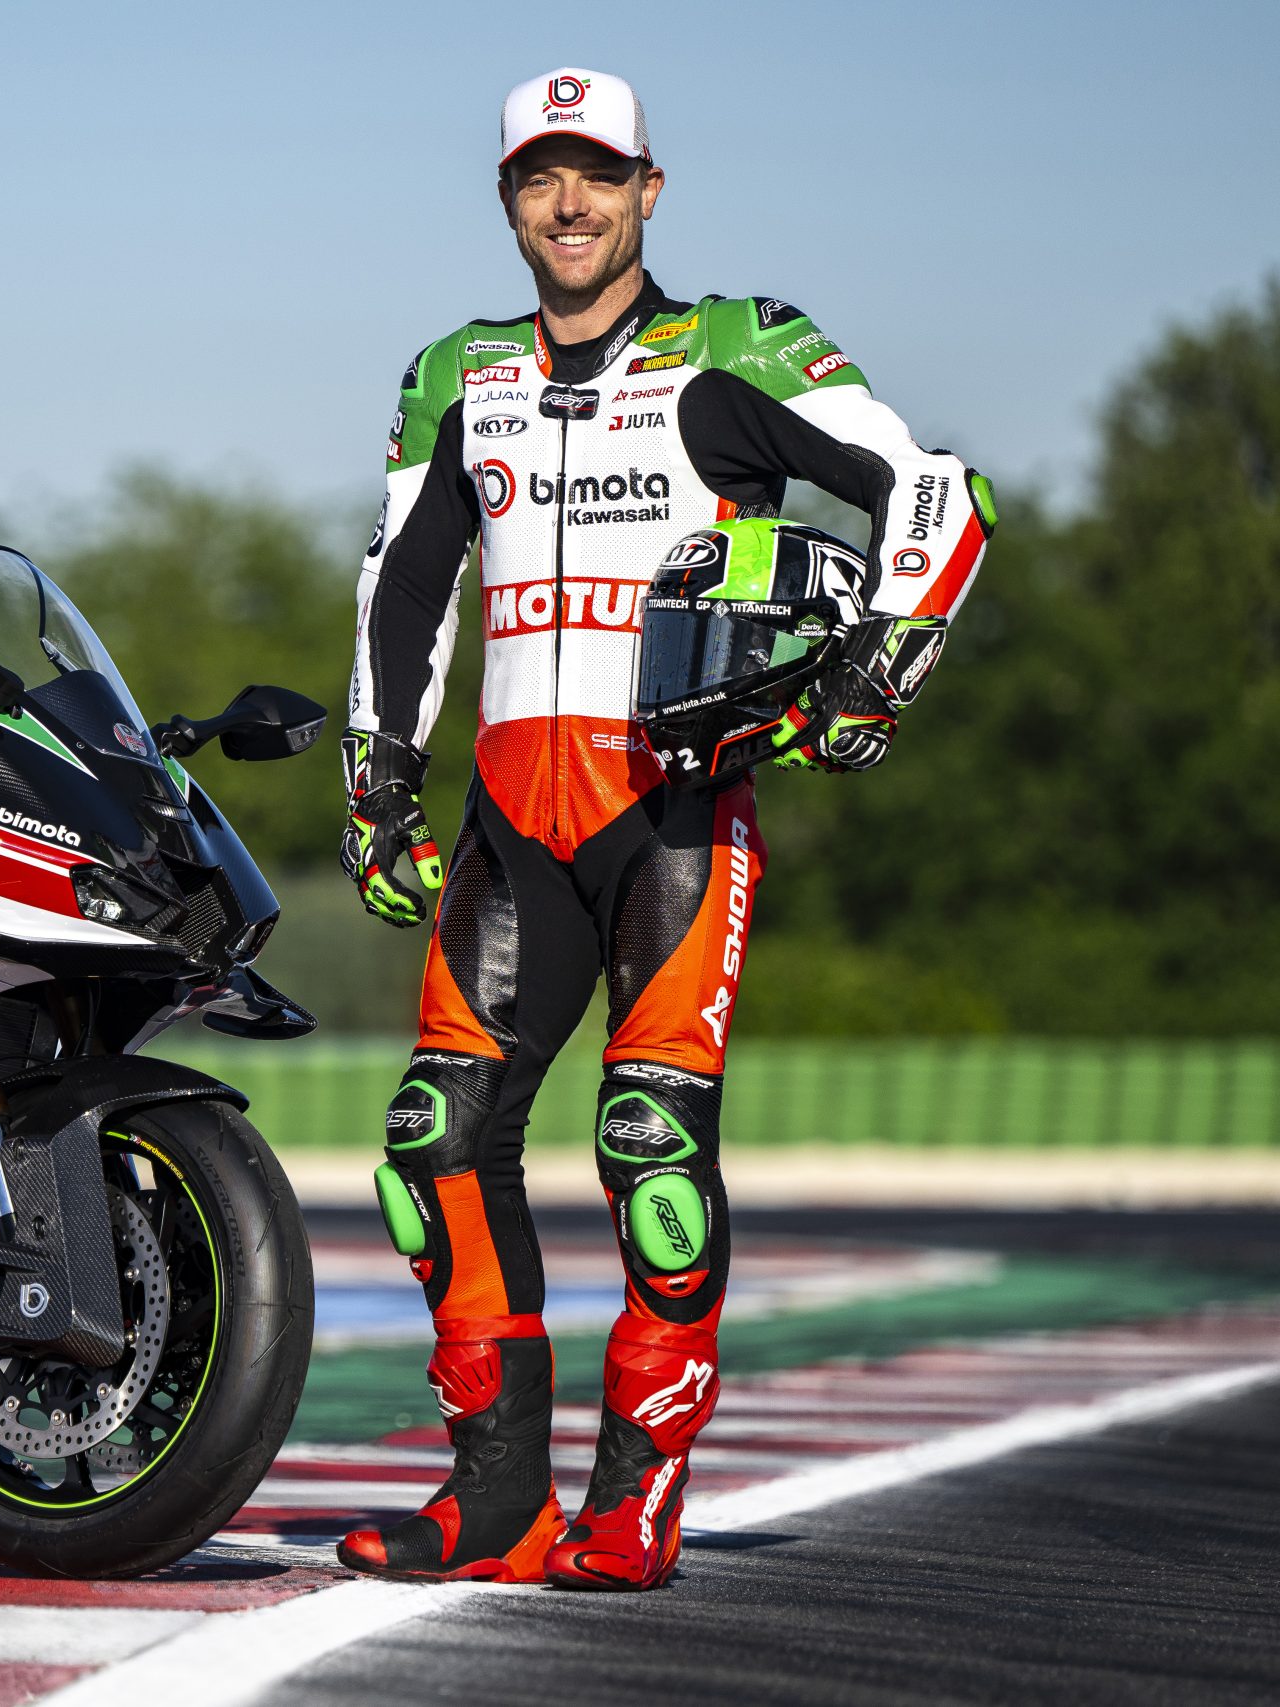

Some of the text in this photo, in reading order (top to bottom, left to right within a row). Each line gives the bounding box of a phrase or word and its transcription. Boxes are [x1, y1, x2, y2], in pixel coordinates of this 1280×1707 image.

[604, 316, 639, 367] RST
[465, 368, 517, 383] MOTUL
[809, 353, 850, 380] MOTU
[541, 392, 599, 409] RST
[630, 385, 675, 400] SHOWA
[477, 418, 523, 435] KYT
[624, 412, 667, 430] JUTA
[529, 466, 670, 506] bimota
[906, 474, 936, 542] bimota
[932, 476, 950, 529] Kawasaki
[567, 503, 670, 527] Kawasaki
[489, 582, 642, 632] MOTU
[648, 599, 689, 610] TITANTECH
[696, 600, 711, 611] GP
[730, 602, 792, 616] TITANTECH
[794, 629, 828, 637] Kawasaki
[662, 691, 728, 716] www.juta.co.uk
[722, 816, 749, 982] SHOWA
[602, 1119, 681, 1145] RST
[649, 1194, 695, 1259] RST
